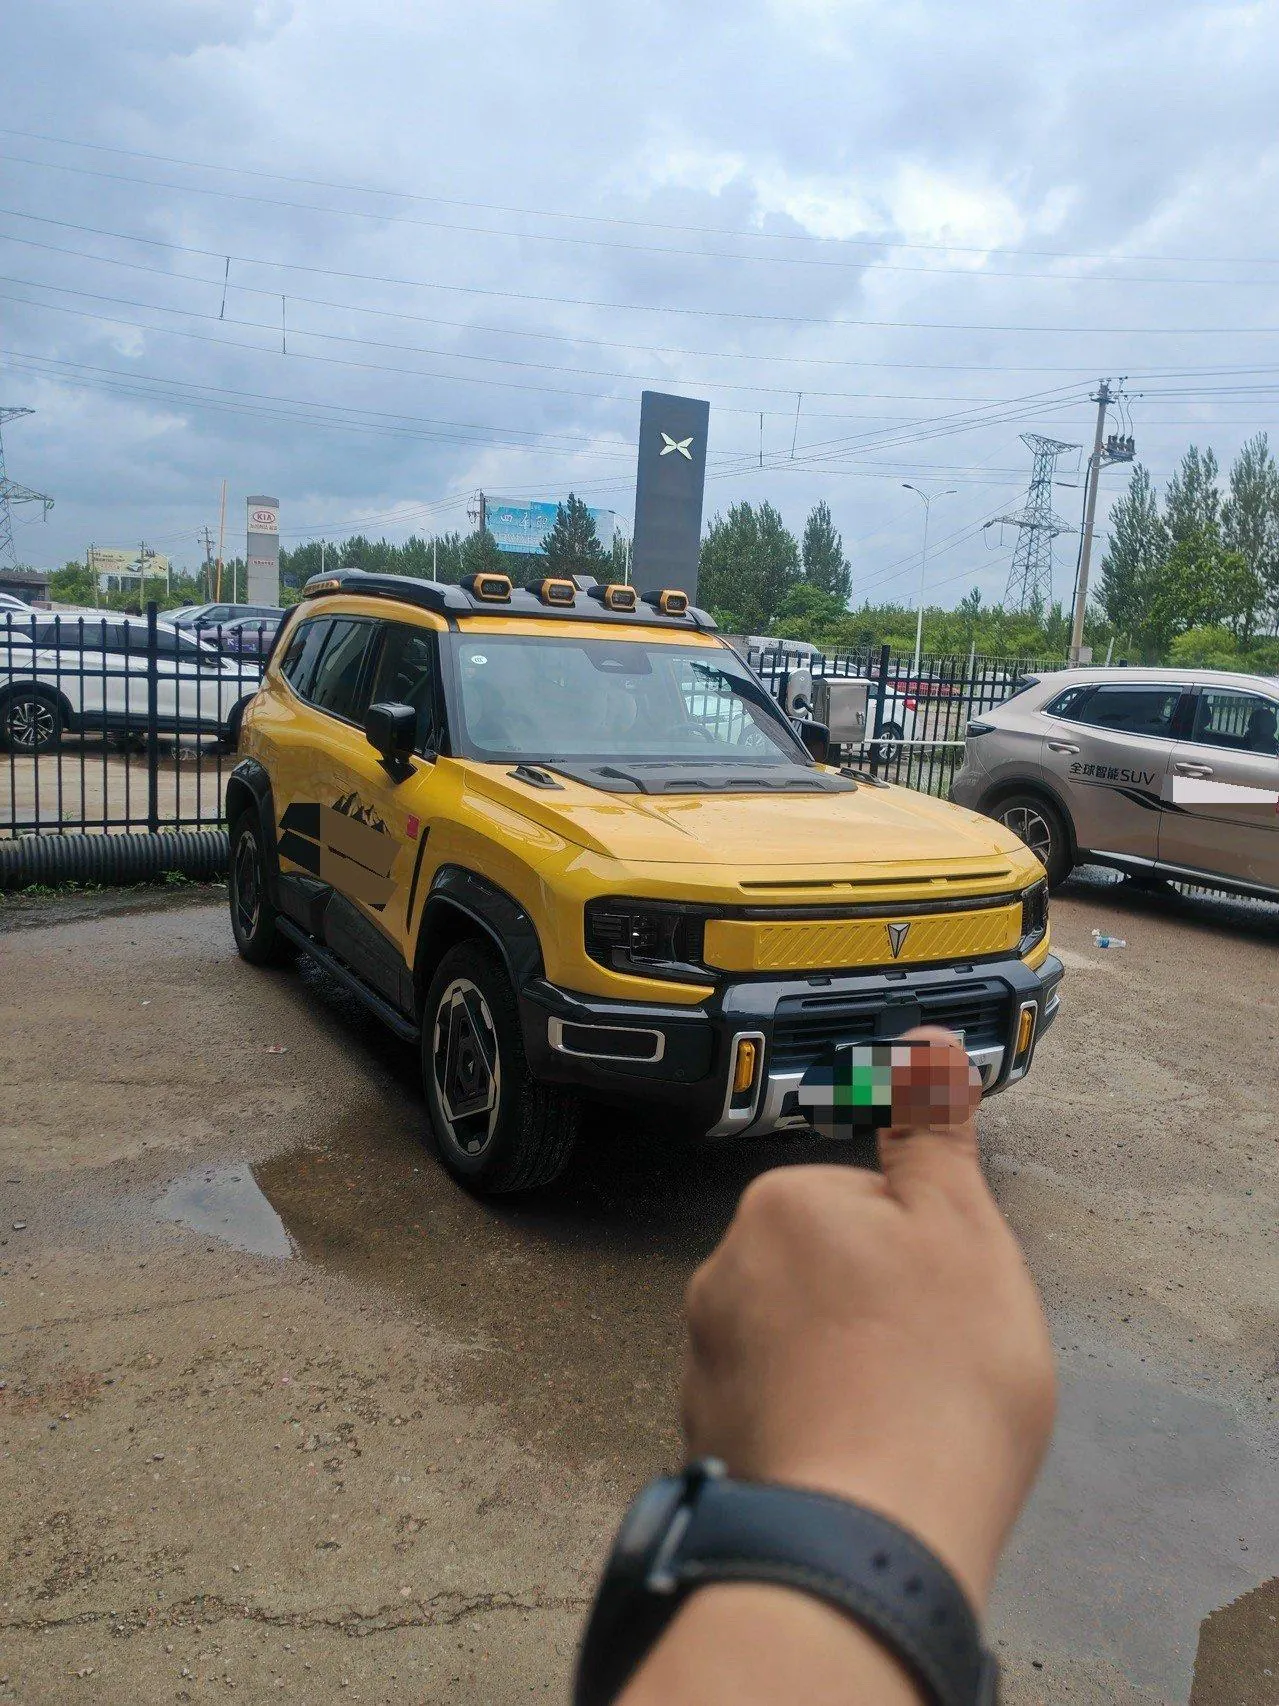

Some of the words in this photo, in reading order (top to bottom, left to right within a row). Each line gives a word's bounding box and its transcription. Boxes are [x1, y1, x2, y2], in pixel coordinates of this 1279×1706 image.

[257, 513, 272, 521] KIA
[1069, 762, 1155, 786] 全球智能SUV
